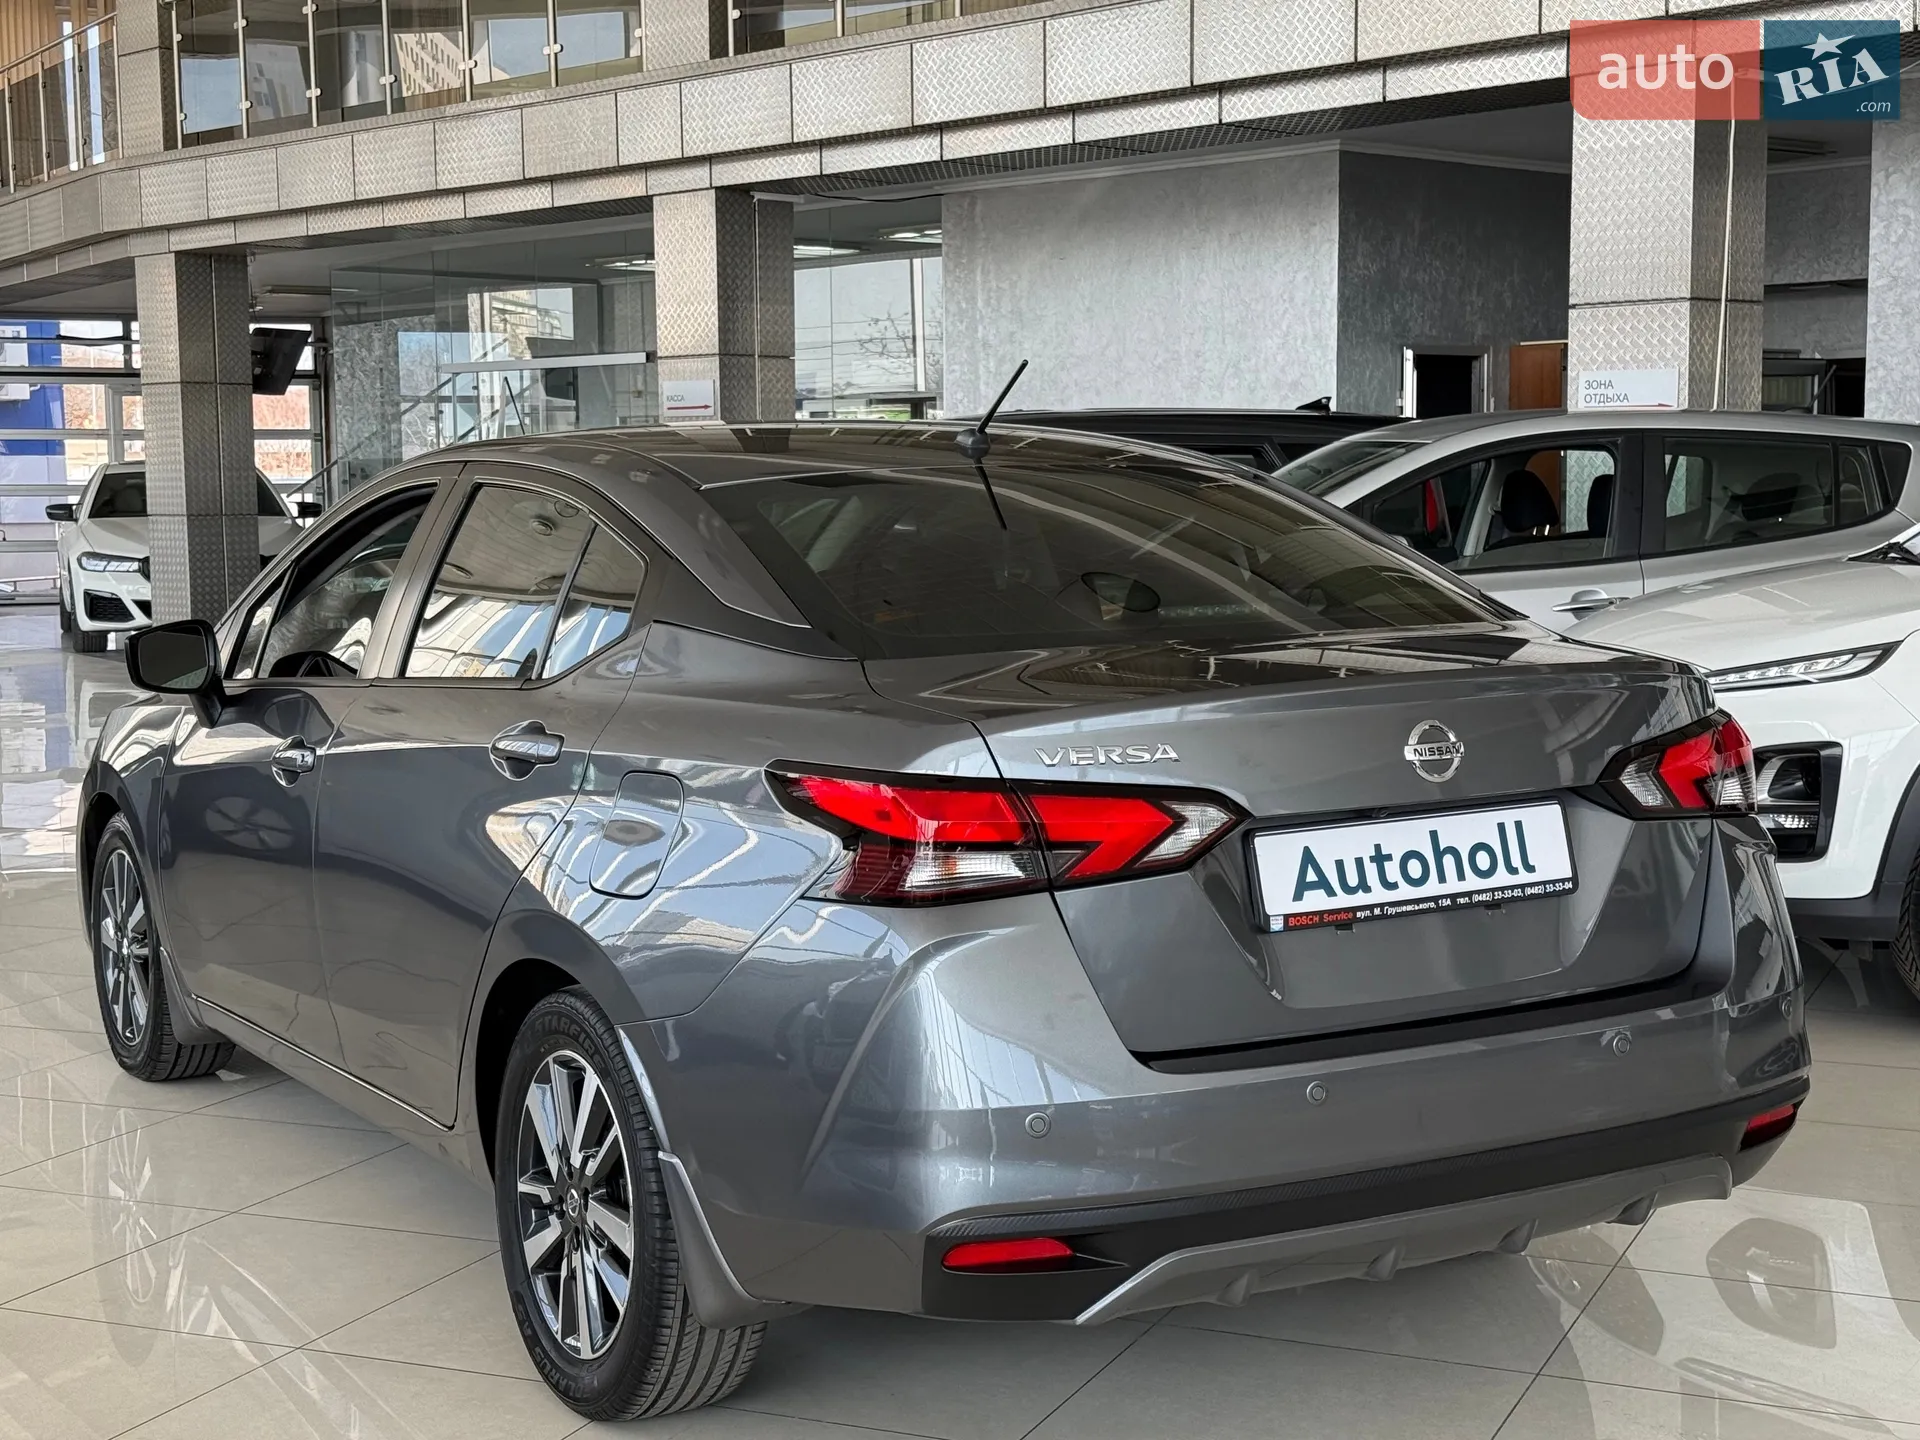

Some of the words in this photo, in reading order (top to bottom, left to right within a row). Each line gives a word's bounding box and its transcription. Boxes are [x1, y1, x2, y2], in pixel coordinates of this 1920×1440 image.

[1584, 379, 1614, 391] ЗОНА
[666, 394, 685, 403] КАССА
[1583, 393, 1630, 405] ОТДЫХА
[1034, 743, 1181, 767] VERSA
[1413, 745, 1460, 757] NISSAN
[1291, 820, 1536, 902] Autoholl
[1288, 914, 1320, 926] BOSCH
[1323, 911, 1354, 923] Service
[1356, 909, 1373, 919] вул.
[1456, 897, 1471, 905] тел.
[1472, 891, 1493, 904] (0482)
[1493, 887, 1524, 899] 33-33-03,
[1524, 884, 1545, 896] (0482)
[1545, 881, 1573, 893] 33-33-04
